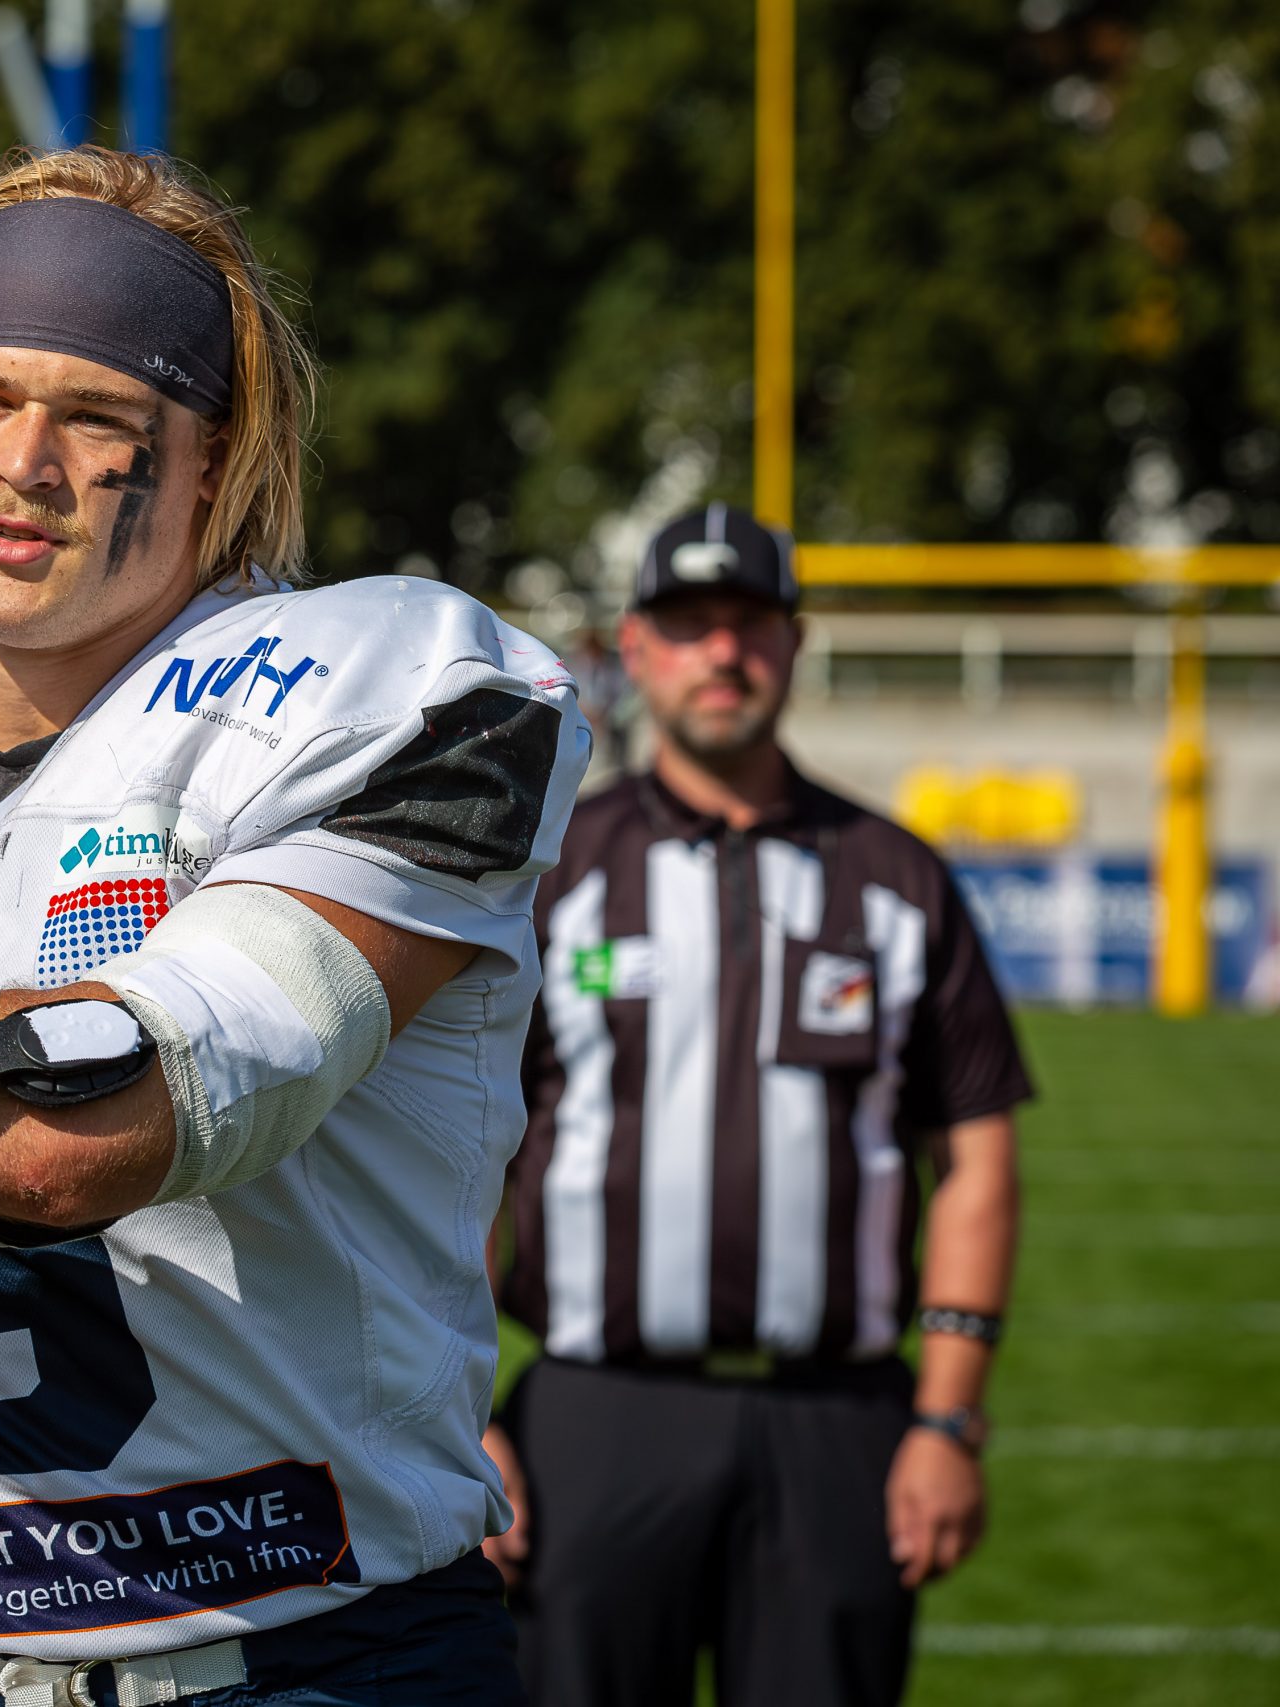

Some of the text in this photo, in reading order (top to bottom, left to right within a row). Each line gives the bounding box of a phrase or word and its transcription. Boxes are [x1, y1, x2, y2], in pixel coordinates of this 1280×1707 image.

[26, 1517, 143, 1561] YOU
[158, 1490, 304, 1546] LOVE.
[143, 1554, 236, 1593] with
[246, 1541, 322, 1573] ifm.
